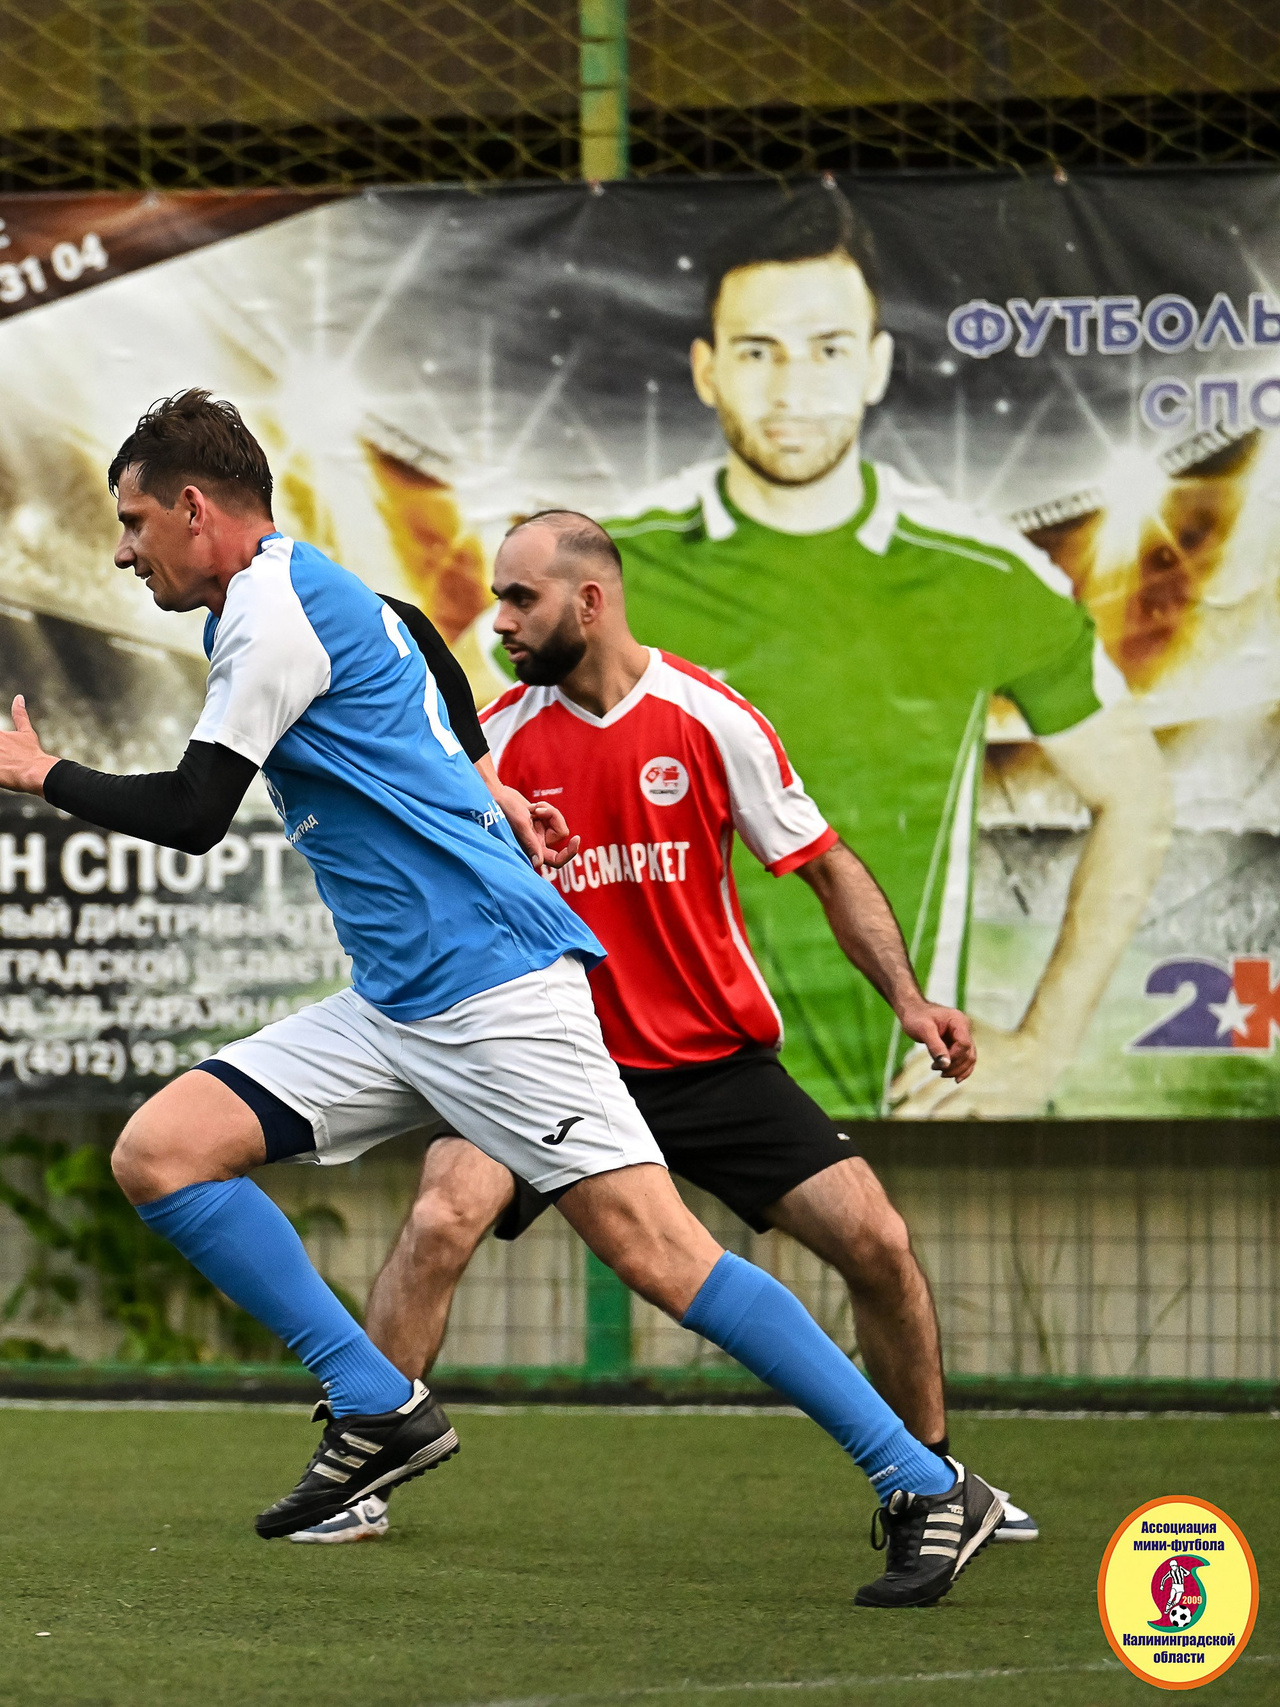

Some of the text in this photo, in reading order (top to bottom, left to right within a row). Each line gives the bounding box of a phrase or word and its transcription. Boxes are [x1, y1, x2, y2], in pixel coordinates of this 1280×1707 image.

[50, 232, 110, 284] 04
[1140, 375, 1280, 433] СПО
[60, 832, 288, 896] СПОРТ
